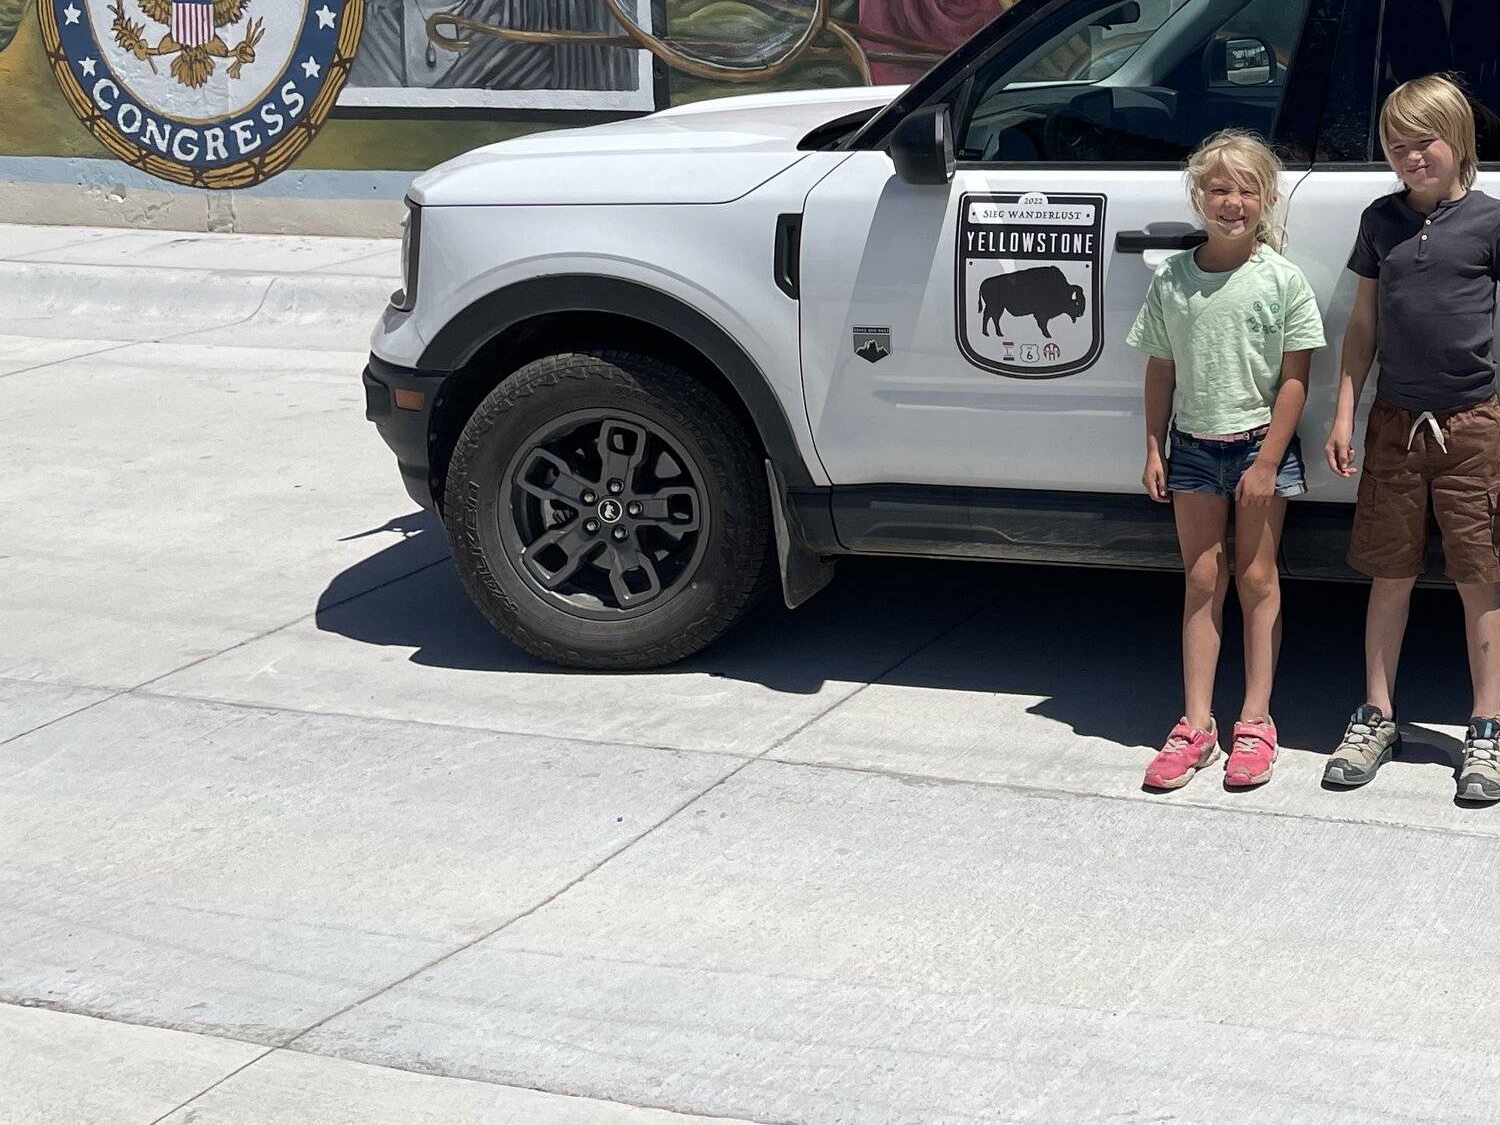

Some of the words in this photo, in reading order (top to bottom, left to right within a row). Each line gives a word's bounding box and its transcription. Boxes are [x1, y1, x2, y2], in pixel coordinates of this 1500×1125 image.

[92, 77, 306, 163] CONGRESS
[1024, 197, 1044, 205] 2022
[982, 209, 1005, 219] SIEG
[1008, 210, 1083, 221] WANDERLUST
[966, 230, 1094, 254] YELLOWSTONE
[1026, 350, 1034, 361] 6
